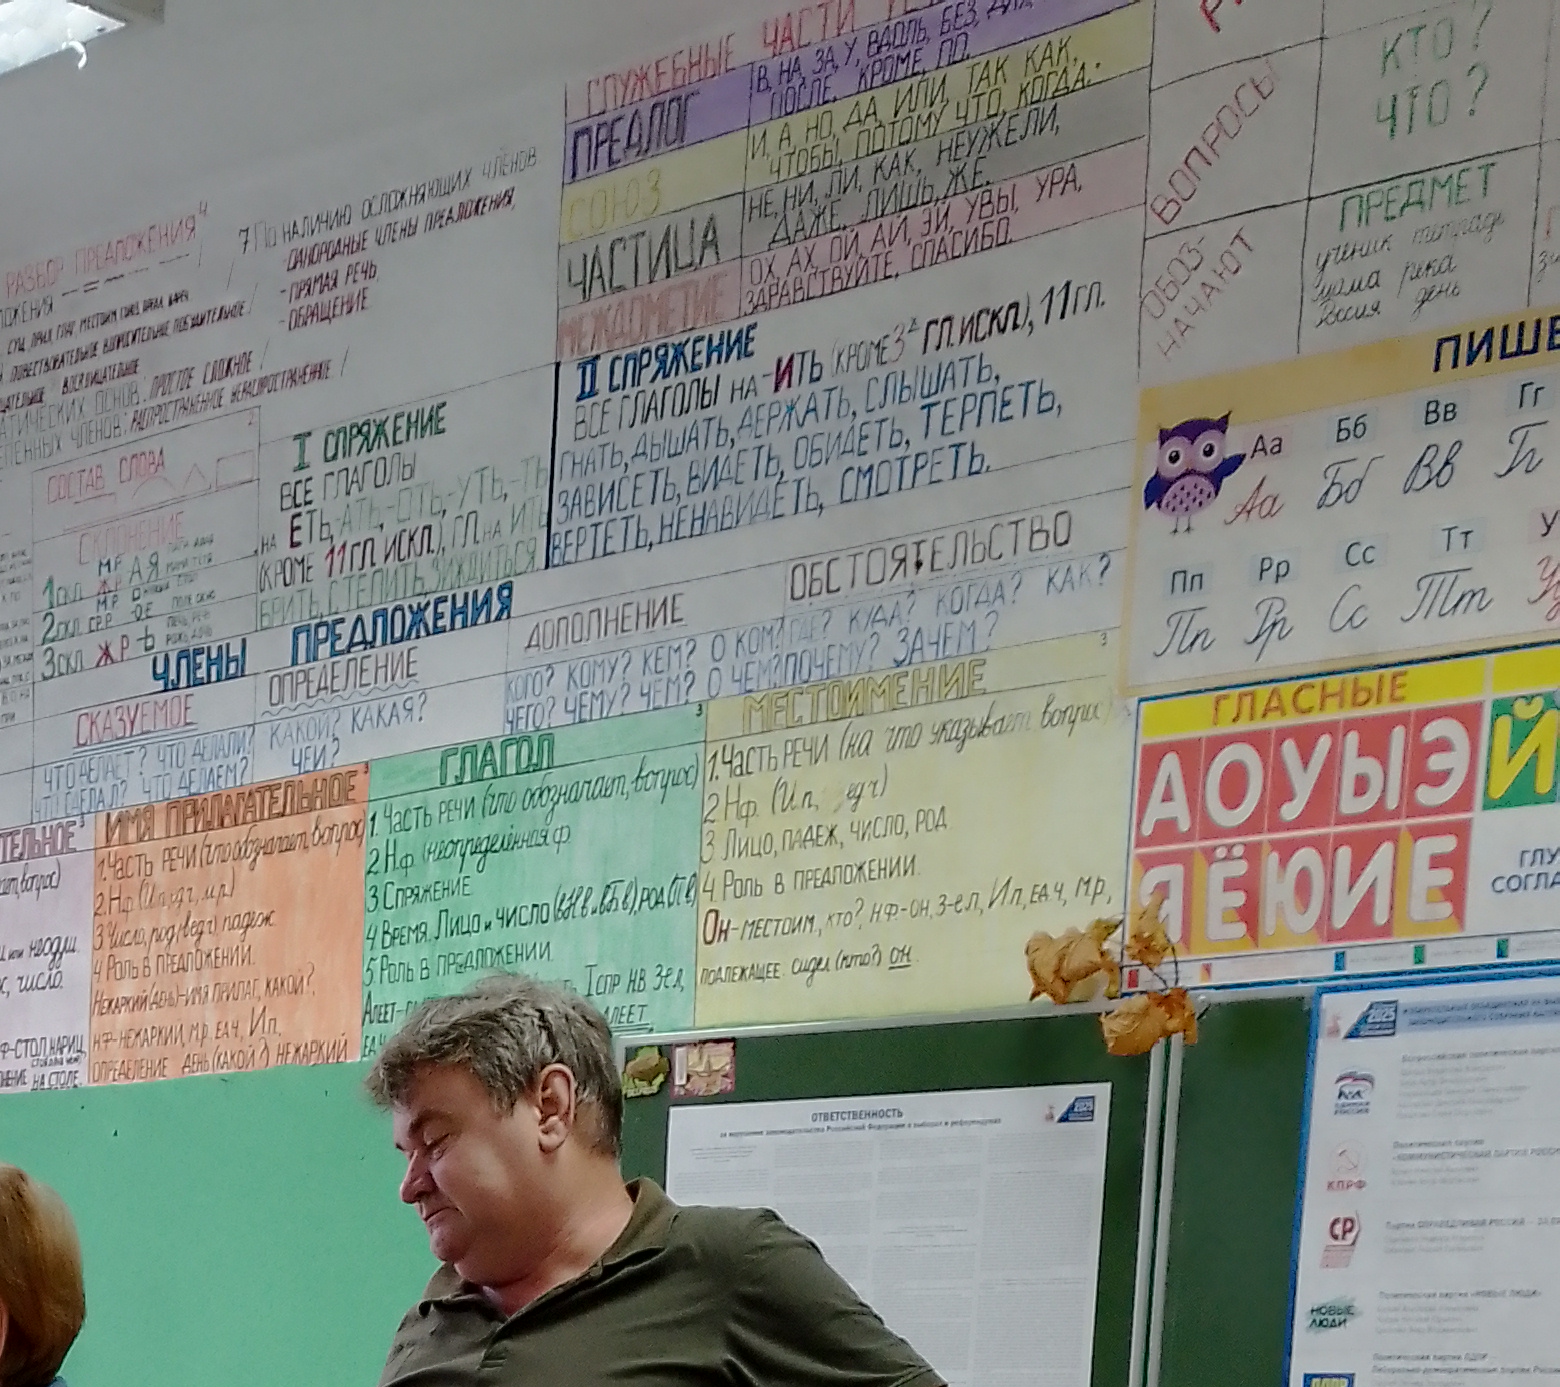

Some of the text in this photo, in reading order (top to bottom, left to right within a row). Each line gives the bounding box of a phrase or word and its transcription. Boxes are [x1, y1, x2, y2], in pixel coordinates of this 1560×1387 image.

[586, 0, 856, 117] СЛУЖЕБНЫЕ ЧАСТИ
[966, 55, 1007, 90] ТАК
[1149, 56, 1283, 226] ВОПРОСЫ
[283, 204, 352, 243] НАЛИЧИЮ
[361, 167, 472, 220] ОСЛОЖНЯЮЩИХ
[1339, 162, 1497, 232] ПРЕДМЕТ
[375, 219, 419, 246] ЧЛЕНЫ
[567, 213, 721, 302] ЧАСТИЦА
[5, 255, 64, 298] РАЗБОР
[608, 321, 758, 394] СПРЯЖЕНИЕ
[323, 401, 448, 463] СПРЯЖЕНИЕ
[574, 399, 611, 442] ВСЕ
[618, 374, 721, 430] ГЛАГОЛЫ
[920, 379, 1062, 439] ТЕРПЕТЬ,
[1250, 382, 1546, 459] Аа Бб Вв Гг
[48, 447, 165, 505] СОСТАВ СЛОВА
[280, 452, 417, 512] ВСЕ ГЛАГОЛЫ
[1224, 420, 1550, 527] Аа Бб Вв Гг
[1170, 526, 1475, 595] Пп Рр Сс Тт
[75, 509, 1073, 748] СКАЗУЕМОЕ ОПРЕДЕЛЕНИЕ ДОПОЛНЕНИЕ ОБСТОЯТЕЛЬСТВО
[152, 637, 248, 692] ЧЛЕНЫ
[291, 580, 515, 667] ПРЕДЛОЖЕНИЯ
[567, 650, 631, 690] КОМУ?
[643, 638, 697, 677] КЕМ?
[1045, 552, 1111, 596] КАК?
[1153, 566, 1493, 663] Пп Рр Сс Тт
[564, 682, 630, 724] ЧЕМУ?
[640, 670, 695, 710] ЧЕМ?
[894, 612, 999, 667] ЗАЧЕМ?
[742, 657, 988, 735] МЕСТОИМЕНИЕ
[1211, 670, 1410, 726] ГЛАСНЫЕ
[351, 691, 428, 734] КАКАЯ?
[438, 732, 555, 785] ГЛАГОЛ
[104, 770, 359, 845] ИМЯ ПРИЛАГАТЕЛЬНОЕ
[277, 1032, 349, 1065] НЕЖАРКИЙ
[810, 1107, 905, 1123] ОТВЕТСТВЕННОСТЬ
[1326, 1179, 1367, 1191] КПРФ
[1329, 1216, 1355, 1241] СР
[1309, 1317, 1348, 1329] ЛЮДИ
[1310, 1304, 1356, 1317] НОВЫЕ
